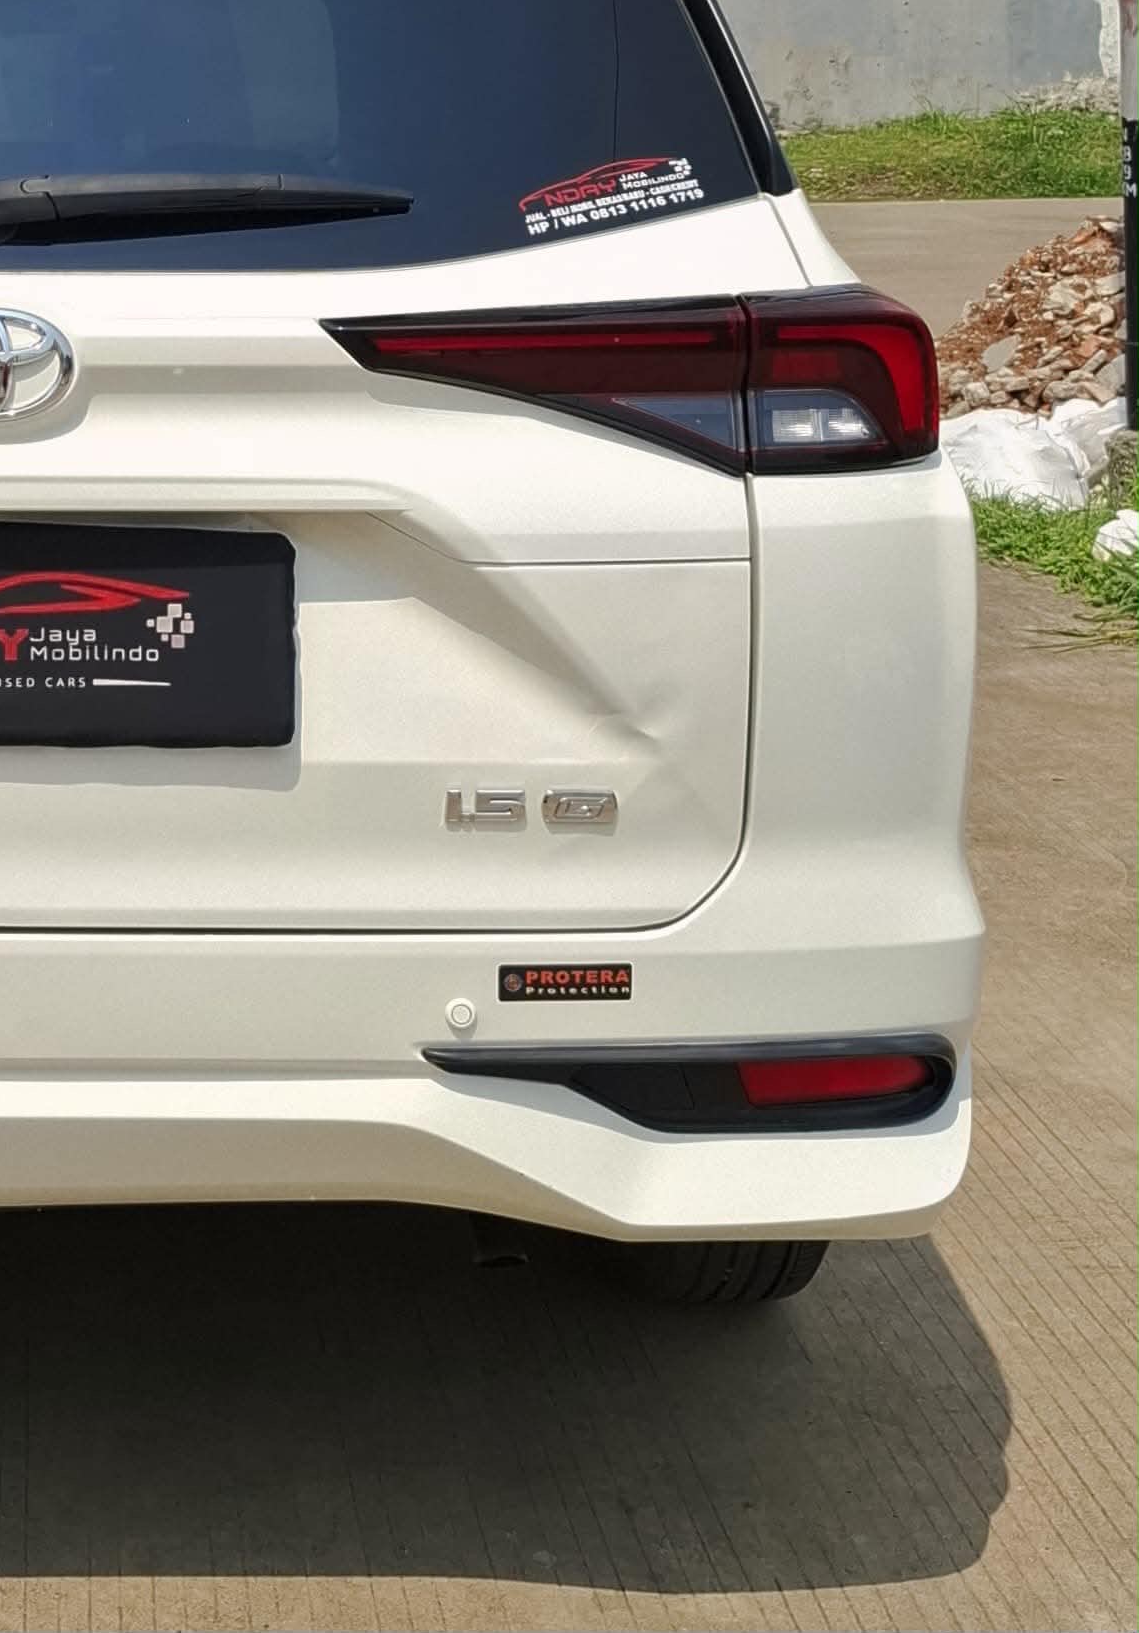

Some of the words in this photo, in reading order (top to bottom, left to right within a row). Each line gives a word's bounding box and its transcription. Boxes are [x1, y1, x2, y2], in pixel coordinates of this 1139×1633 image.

[619, 171, 648, 183] JAYA
[622, 172, 686, 191] MOBILINDO
[527, 221, 550, 236] HP
[560, 213, 589, 227] WA
[589, 203, 628, 220] 0813
[630, 195, 667, 212] 1116
[668, 188, 704, 204] 1719
[29, 627, 97, 646] Jaya
[30, 644, 160, 662] Mobilindo
[45, 677, 86, 688] CARS
[525, 969, 630, 985] PROTERA
[525, 985, 630, 995] Protection
